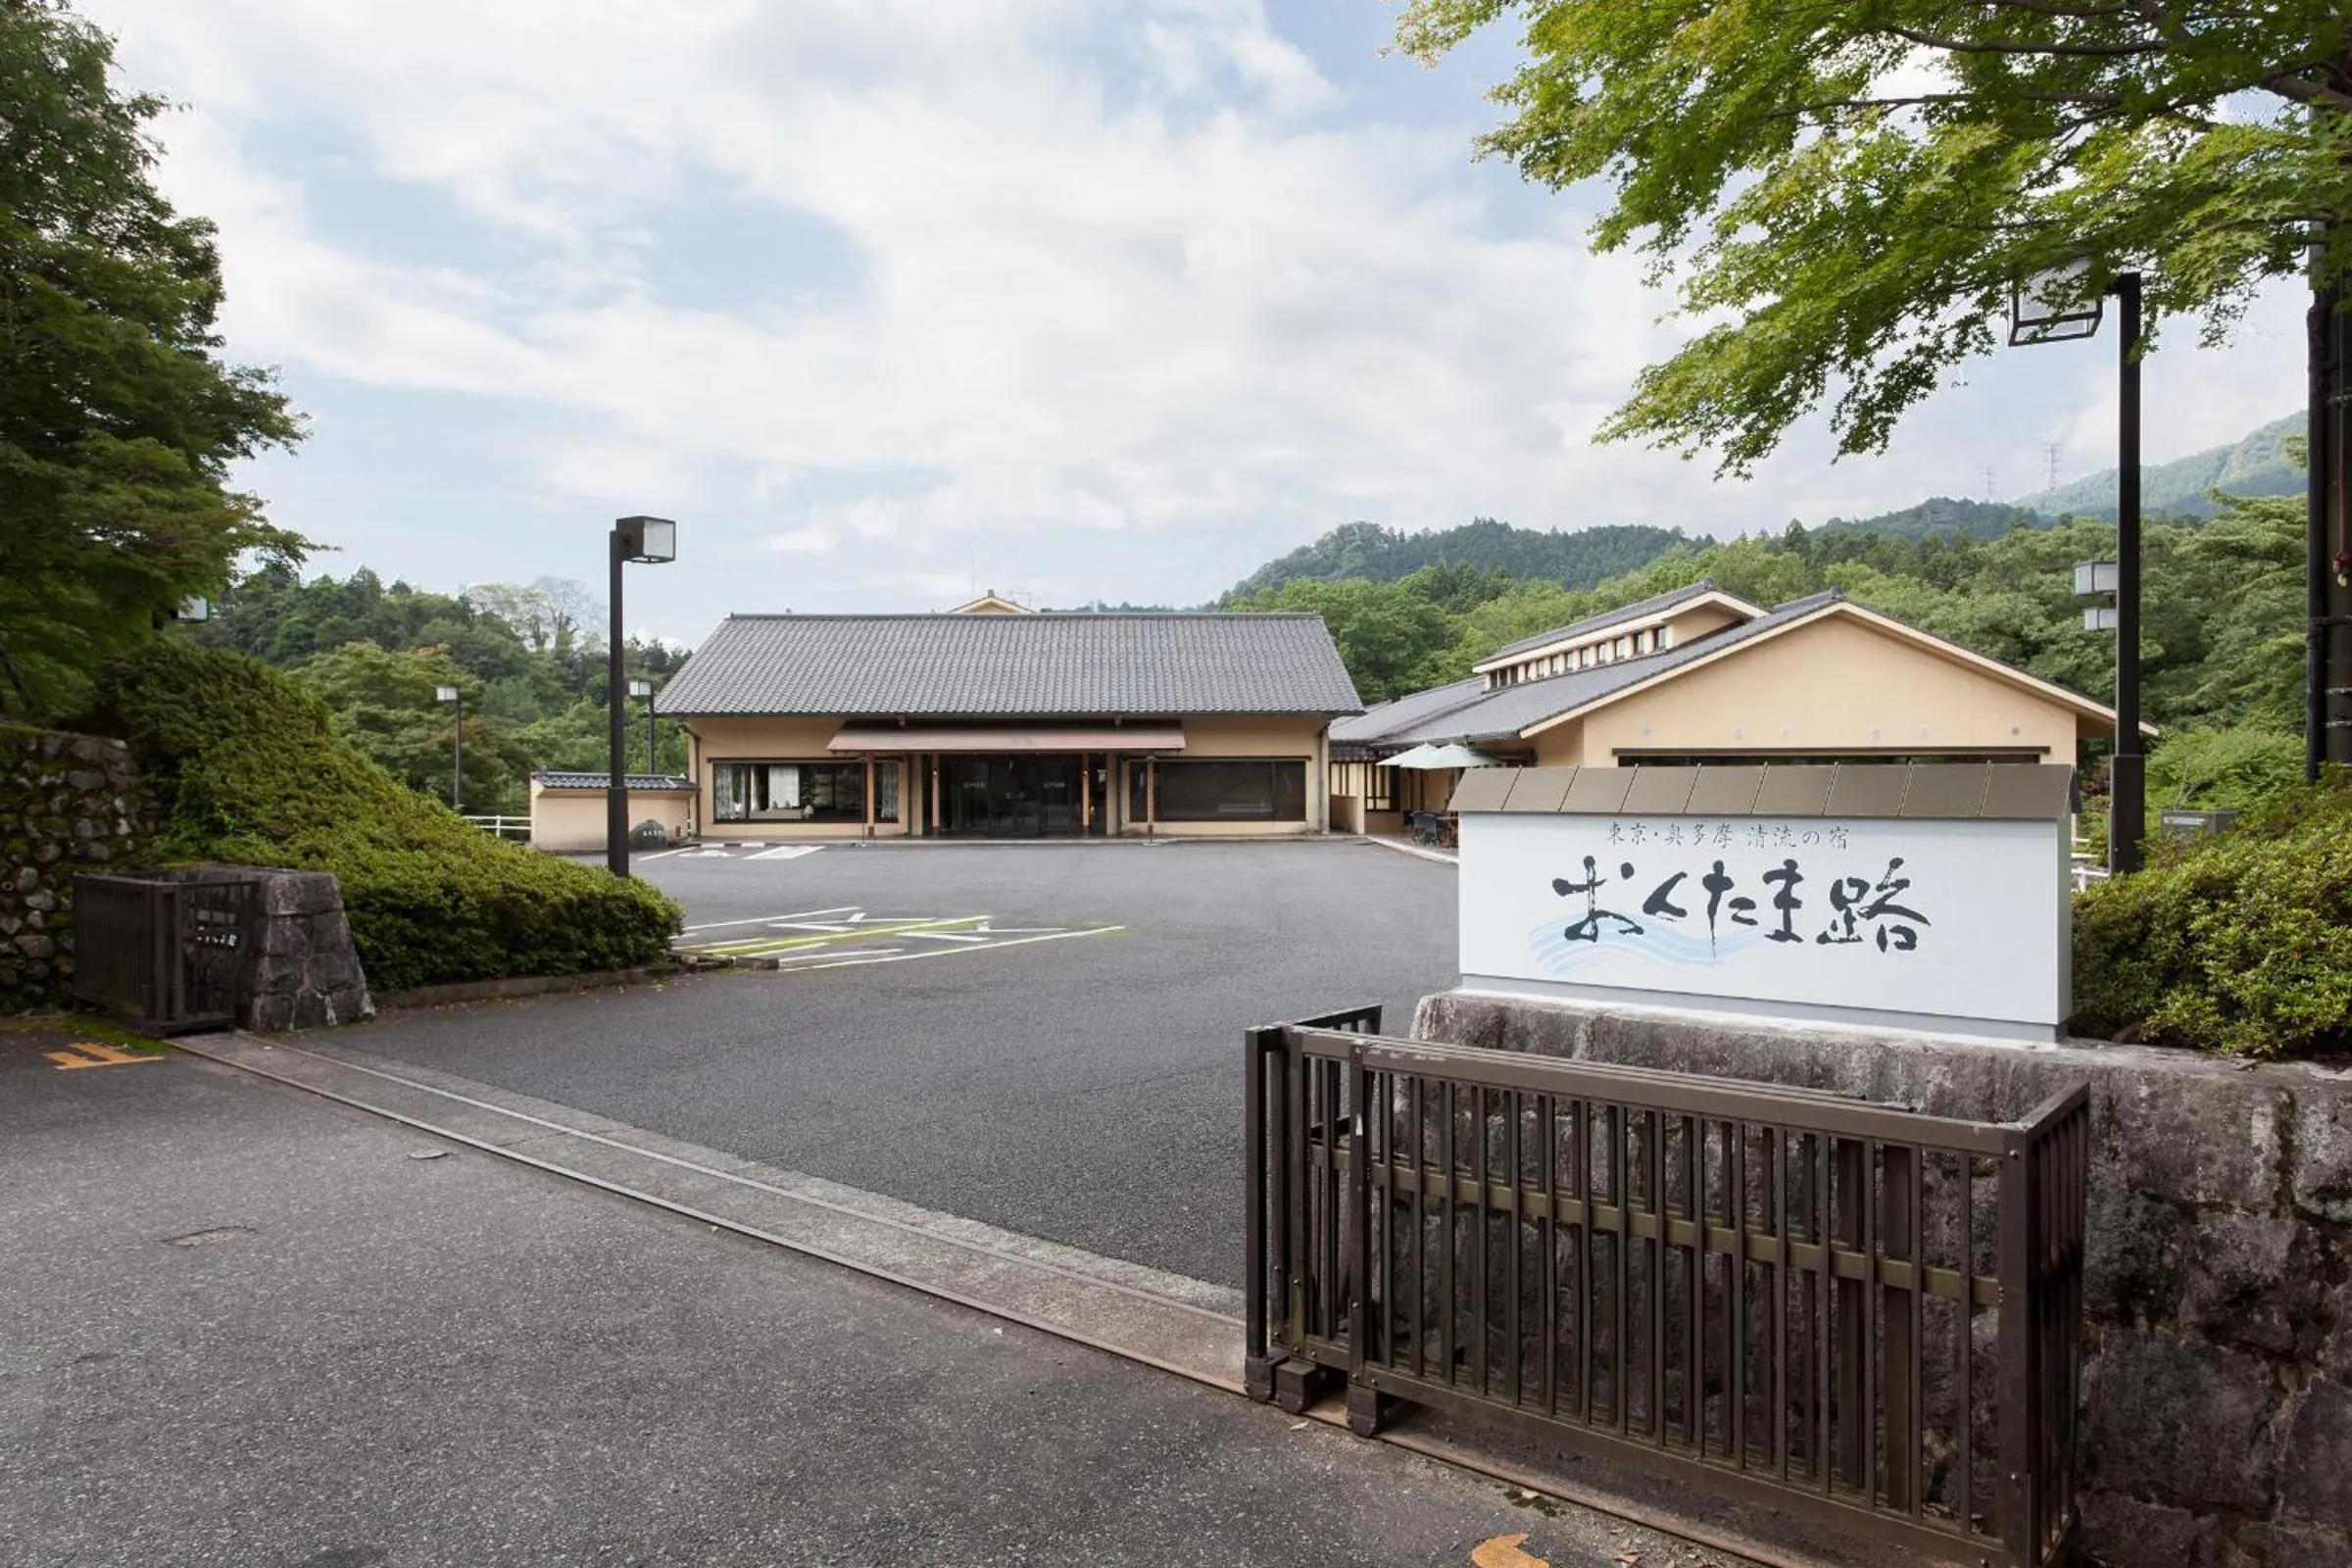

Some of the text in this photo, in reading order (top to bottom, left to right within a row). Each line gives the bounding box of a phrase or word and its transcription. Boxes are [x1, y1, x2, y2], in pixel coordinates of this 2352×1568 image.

[1747, 823, 1849, 850] 清流の宿
[1551, 856, 1931, 956] おくたま路
